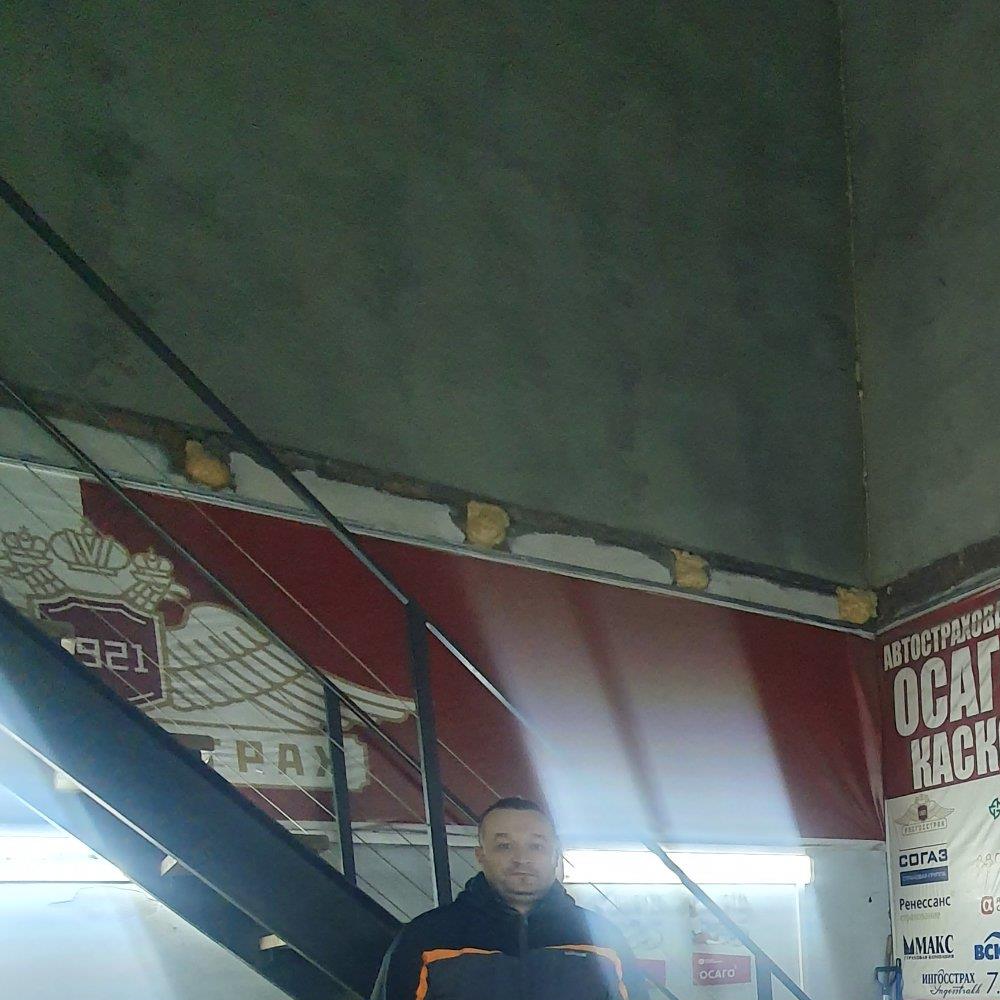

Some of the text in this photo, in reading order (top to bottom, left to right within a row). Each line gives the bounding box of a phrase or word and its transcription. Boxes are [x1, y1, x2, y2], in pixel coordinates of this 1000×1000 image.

[899, 848, 948, 867] СОГАЗ
[899, 896, 951, 911] Ренессанс
[922, 969, 975, 985] ИНГОССТРАХ
